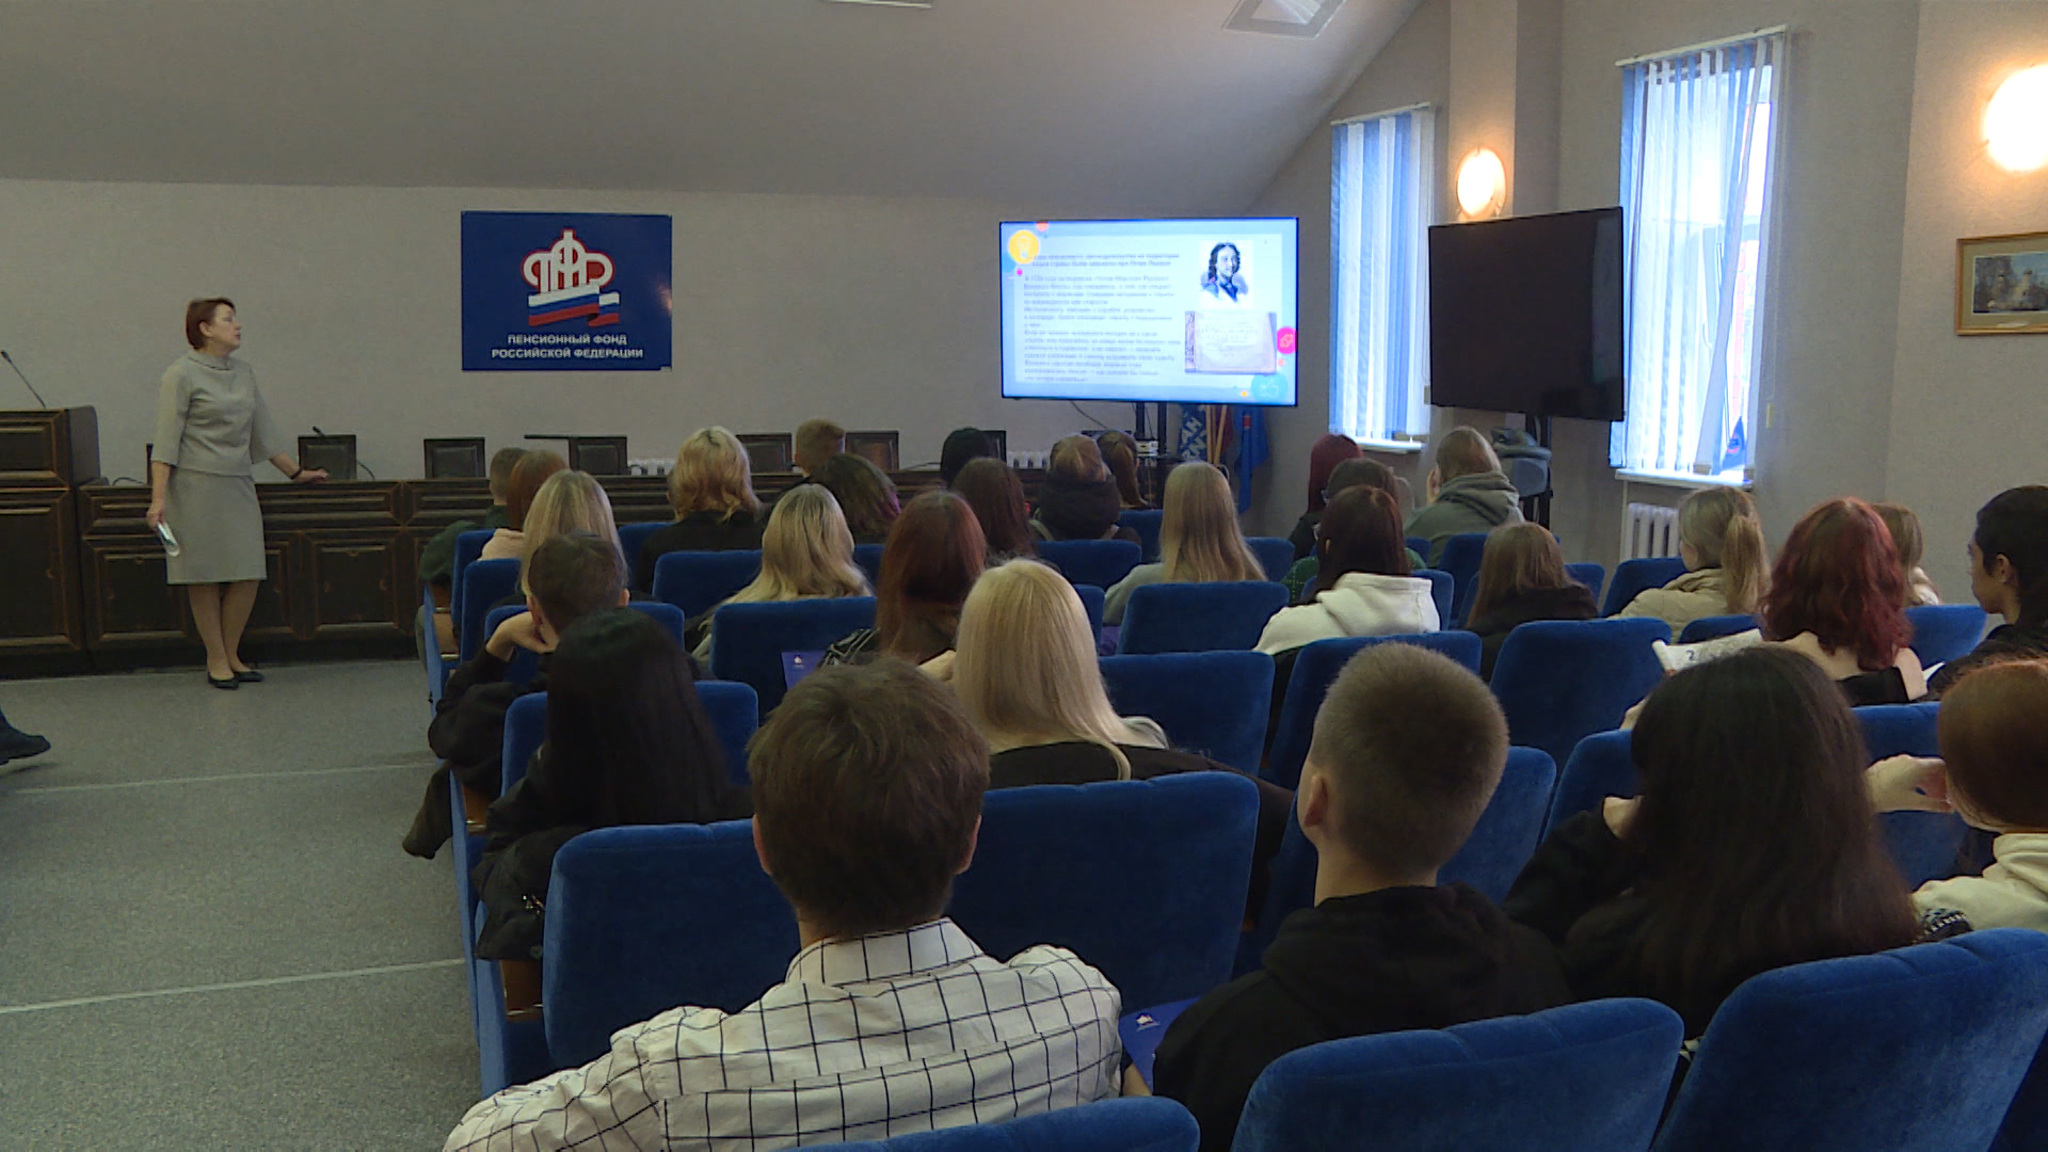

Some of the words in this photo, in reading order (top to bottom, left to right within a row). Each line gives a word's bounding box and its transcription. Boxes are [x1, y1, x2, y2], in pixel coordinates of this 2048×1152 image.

[507, 334, 591, 345] ПЕНСИОННЫЙ
[593, 334, 628, 346] ФОНД
[491, 347, 571, 359] РОССИЙСКОЙ
[573, 348, 644, 359] ФЕДЕРАЦИИ
